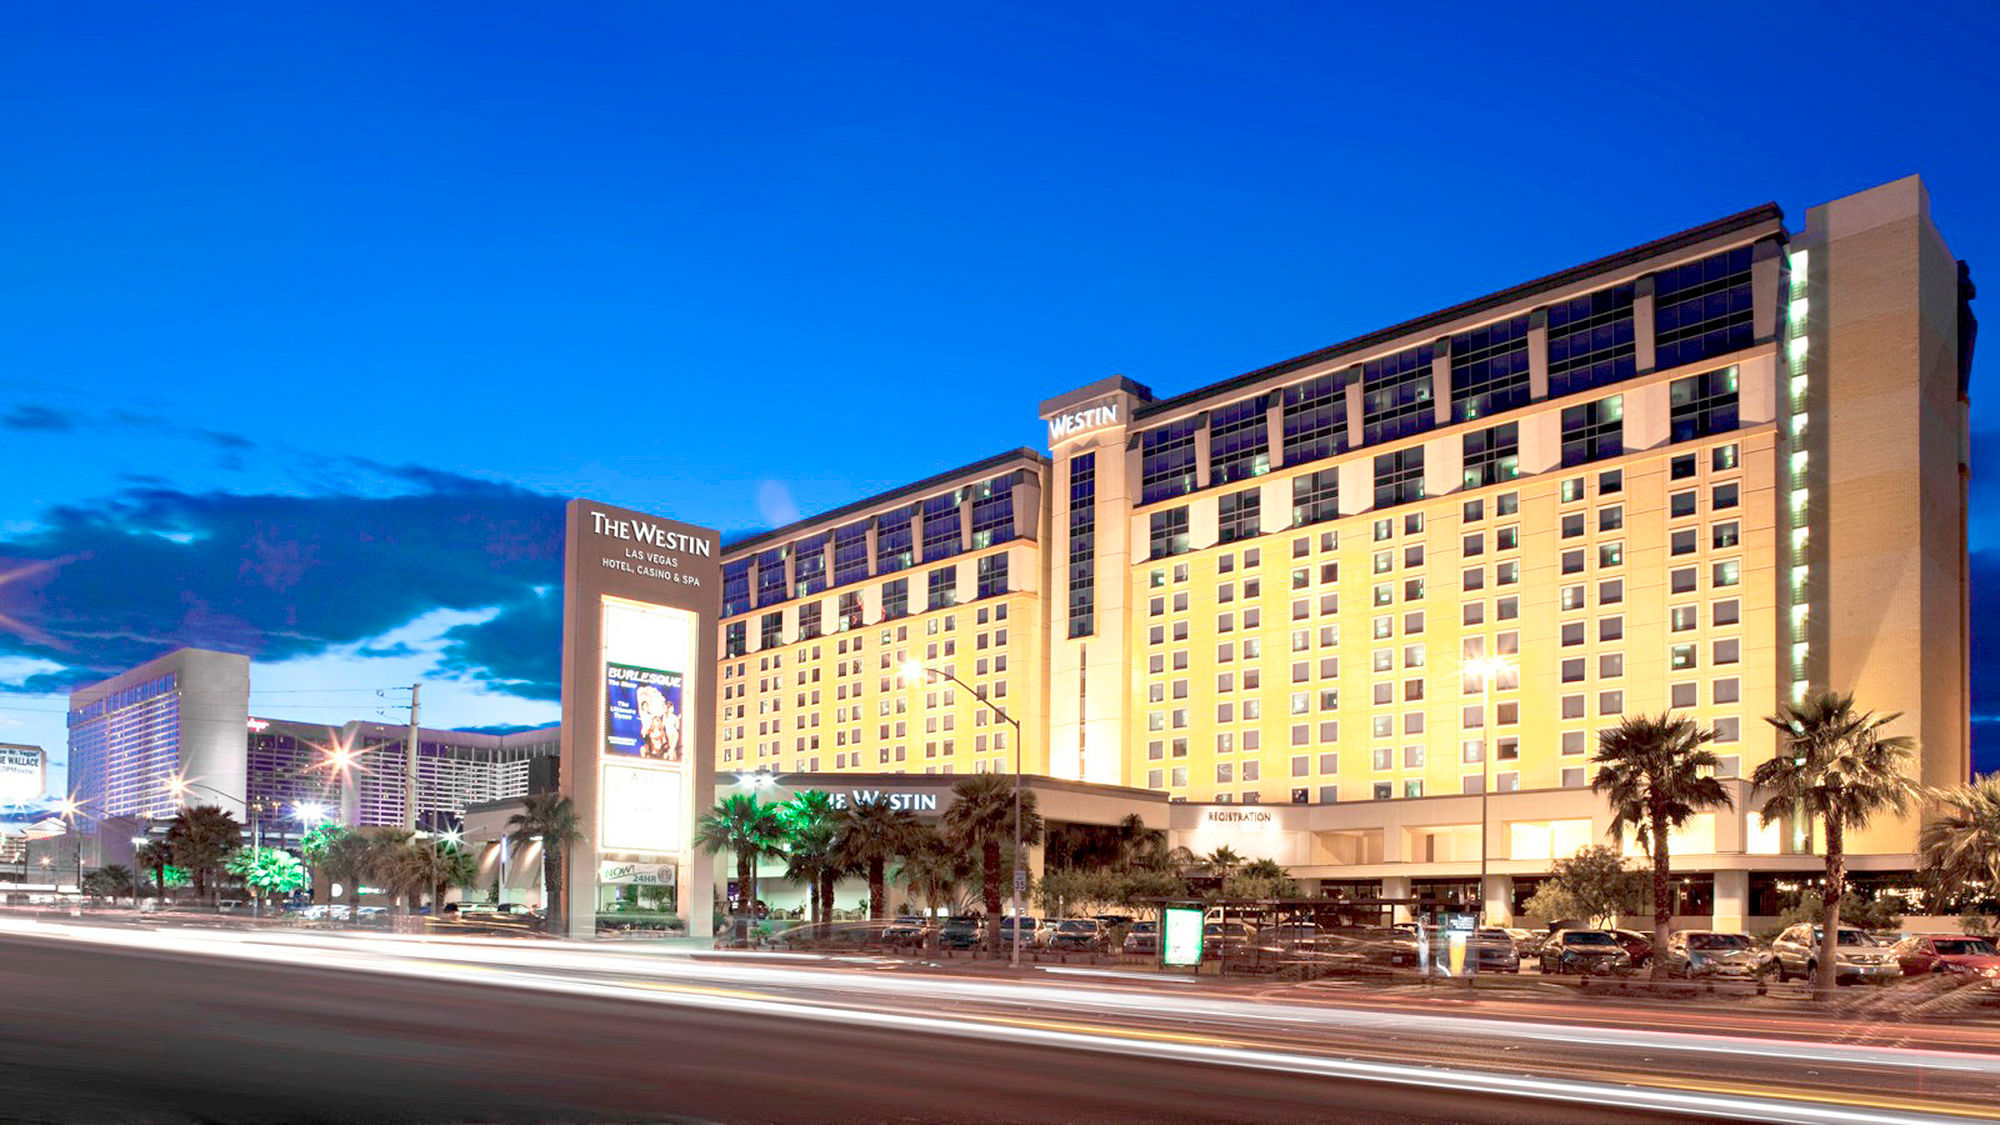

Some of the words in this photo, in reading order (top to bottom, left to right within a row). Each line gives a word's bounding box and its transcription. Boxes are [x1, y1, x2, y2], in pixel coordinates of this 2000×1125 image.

[1049, 404, 1118, 440] WESTIN
[591, 511, 630, 540] THE
[630, 519, 710, 557] WESTIN
[625, 547, 644, 560] LAS
[646, 553, 678, 568] VEGAS
[636, 565, 671, 581] CASINO
[673, 573, 680, 582] &
[682, 575, 701, 587] SPA
[608, 667, 681, 688] BURLESQUE
[8, 756, 39, 767] WALLACE
[1208, 811, 1271, 822] REGISTRATION
